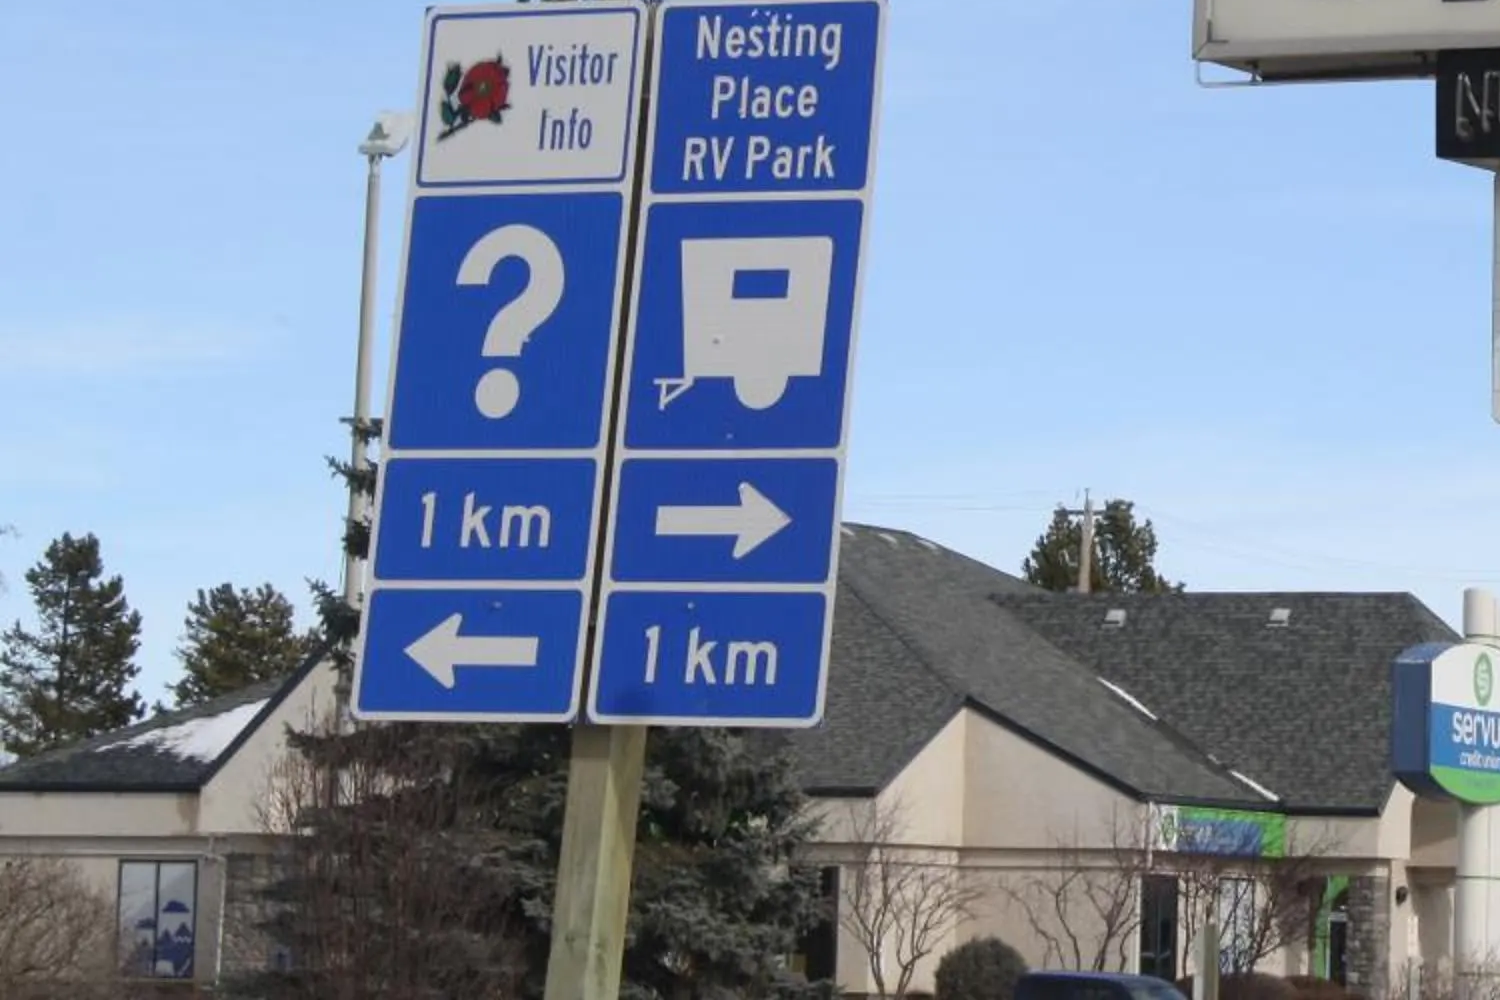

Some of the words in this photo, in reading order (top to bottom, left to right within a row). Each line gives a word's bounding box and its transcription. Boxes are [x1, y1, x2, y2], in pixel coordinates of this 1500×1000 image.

[528, 43, 618, 87] Visitor
[696, 12, 843, 71] Nesting
[711, 74, 820, 120] Place
[538, 107, 593, 151] Info
[682, 135, 735, 181] RV
[745, 134, 836, 180] Park
[420, 491, 438, 549] 1
[459, 490, 551, 549] km
[643, 625, 661, 685] 1
[684, 625, 778, 686] km
